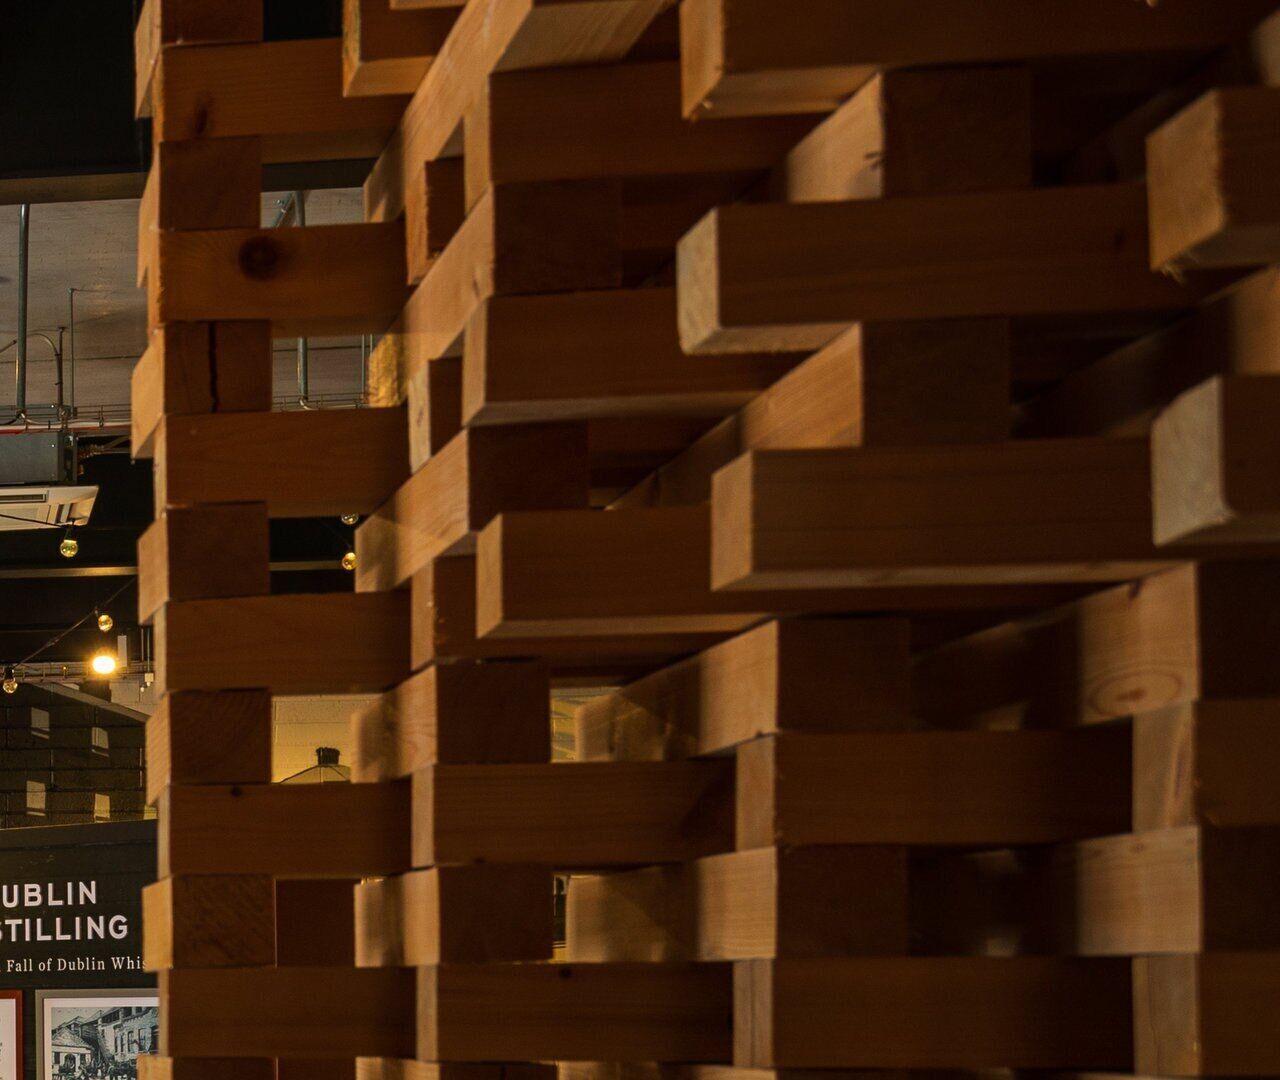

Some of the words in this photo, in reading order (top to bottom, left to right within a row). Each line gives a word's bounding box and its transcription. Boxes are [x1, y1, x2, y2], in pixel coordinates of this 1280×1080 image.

[6, 958, 33, 973] Fall
[38, 957, 53, 972] of
[57, 957, 105, 971] Dublin
